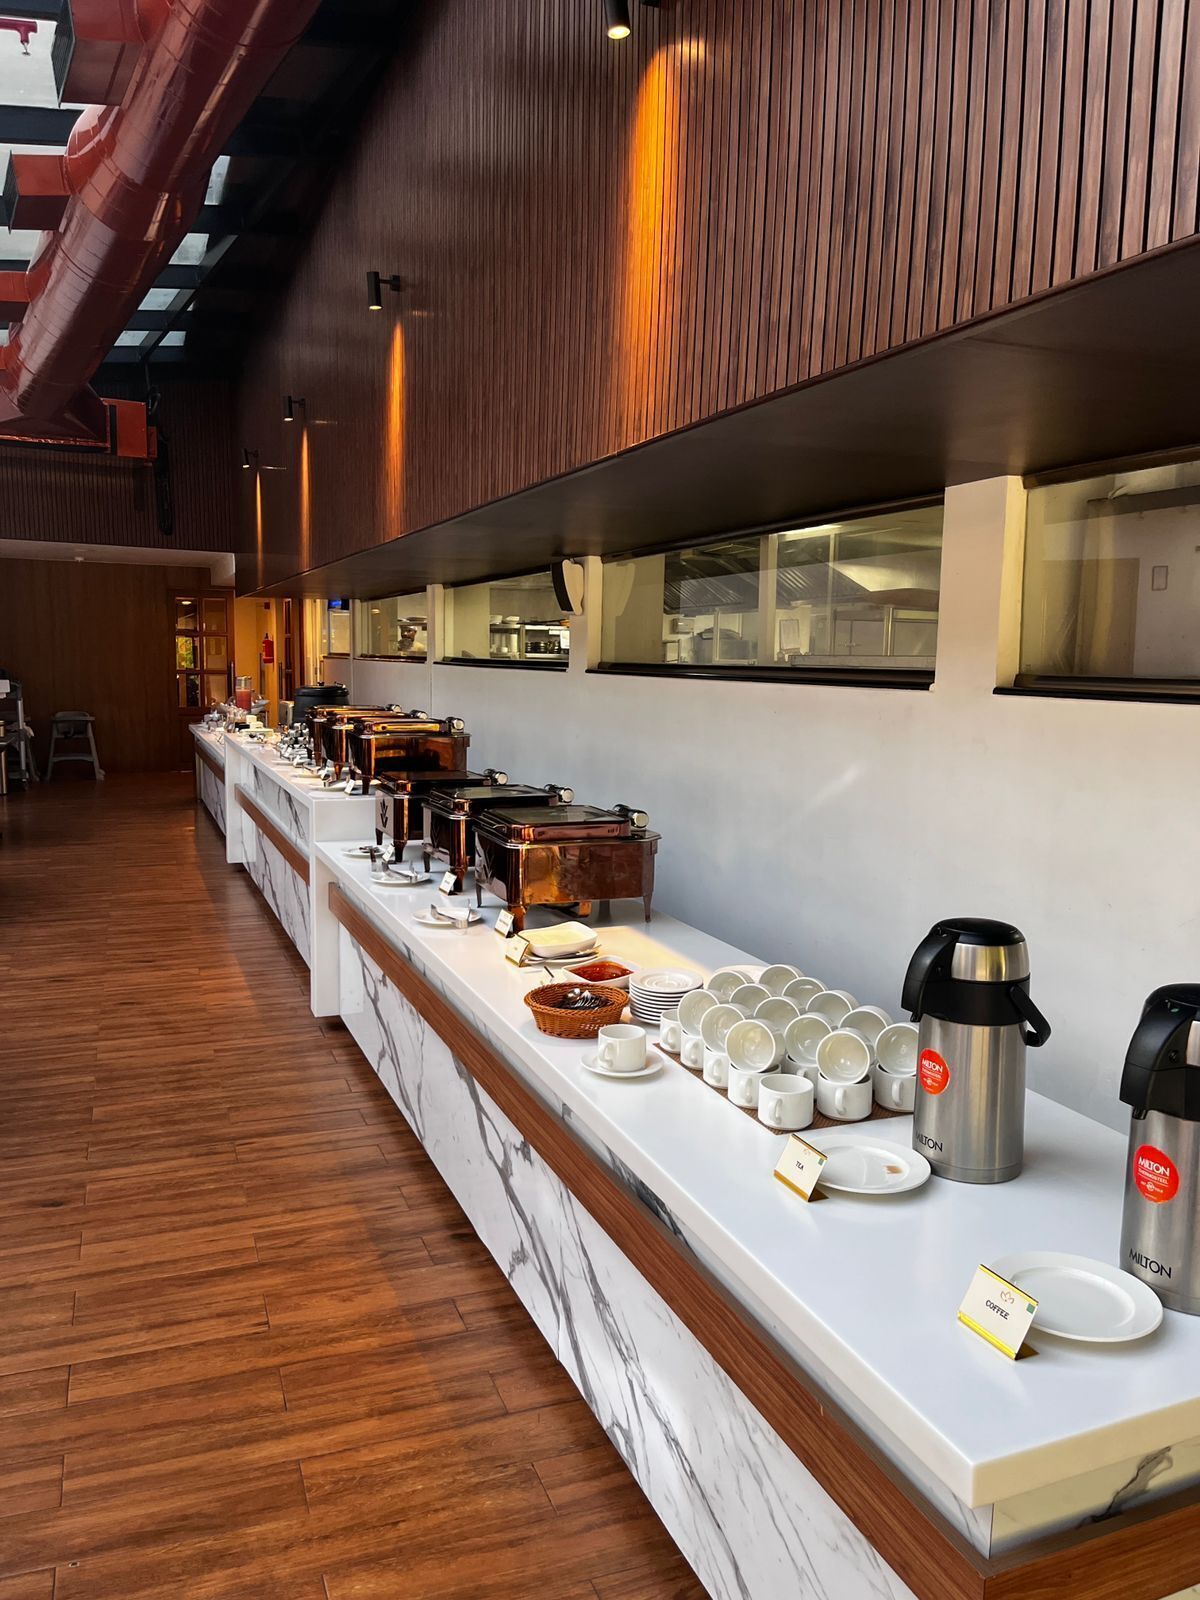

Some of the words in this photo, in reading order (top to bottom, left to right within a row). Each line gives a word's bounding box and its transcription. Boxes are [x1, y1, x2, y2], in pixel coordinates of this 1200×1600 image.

[921, 1058, 943, 1073] MILTON
[795, 1160, 804, 1171] TEA
[1138, 1156, 1170, 1177] MILTON
[1129, 1248, 1172, 1279] MILTON
[985, 1299, 1010, 1320] COFFEE
